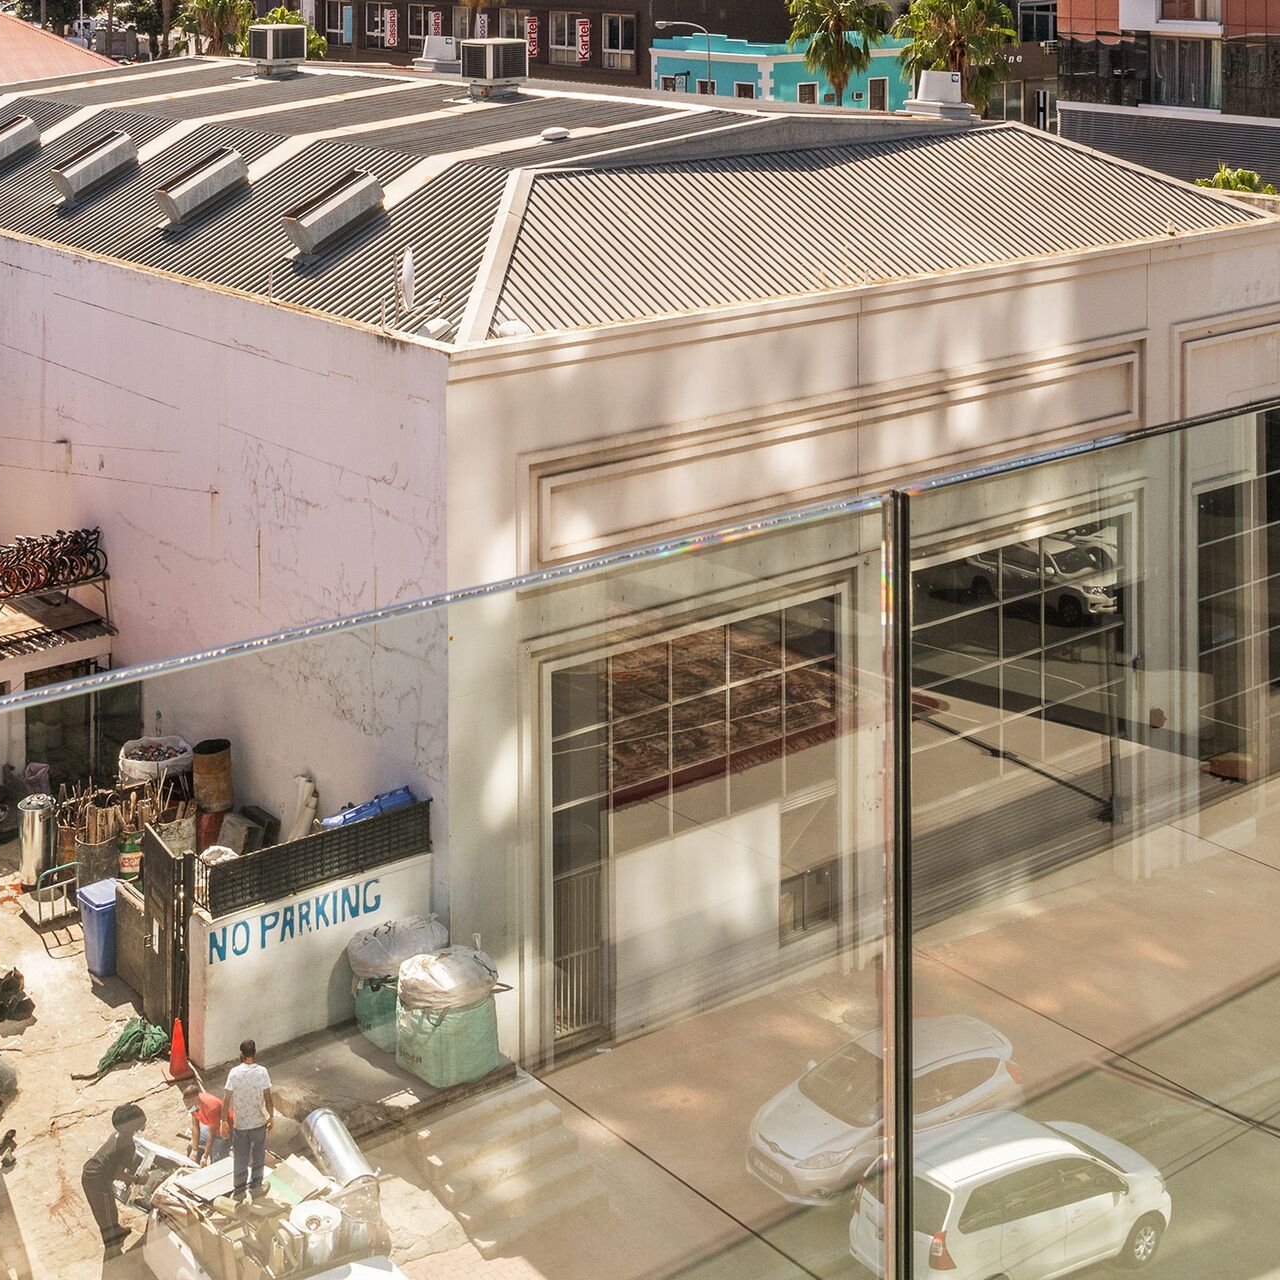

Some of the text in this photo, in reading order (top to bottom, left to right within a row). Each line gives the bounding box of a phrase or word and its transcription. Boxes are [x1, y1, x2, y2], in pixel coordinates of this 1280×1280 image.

[387, 10, 397, 46] Cassina
[433, 12, 441, 37] ssina
[527, 18, 538, 56] Kartell
[578, 19, 590, 60] Kartell
[208, 878, 382, 966] NO PARKING
